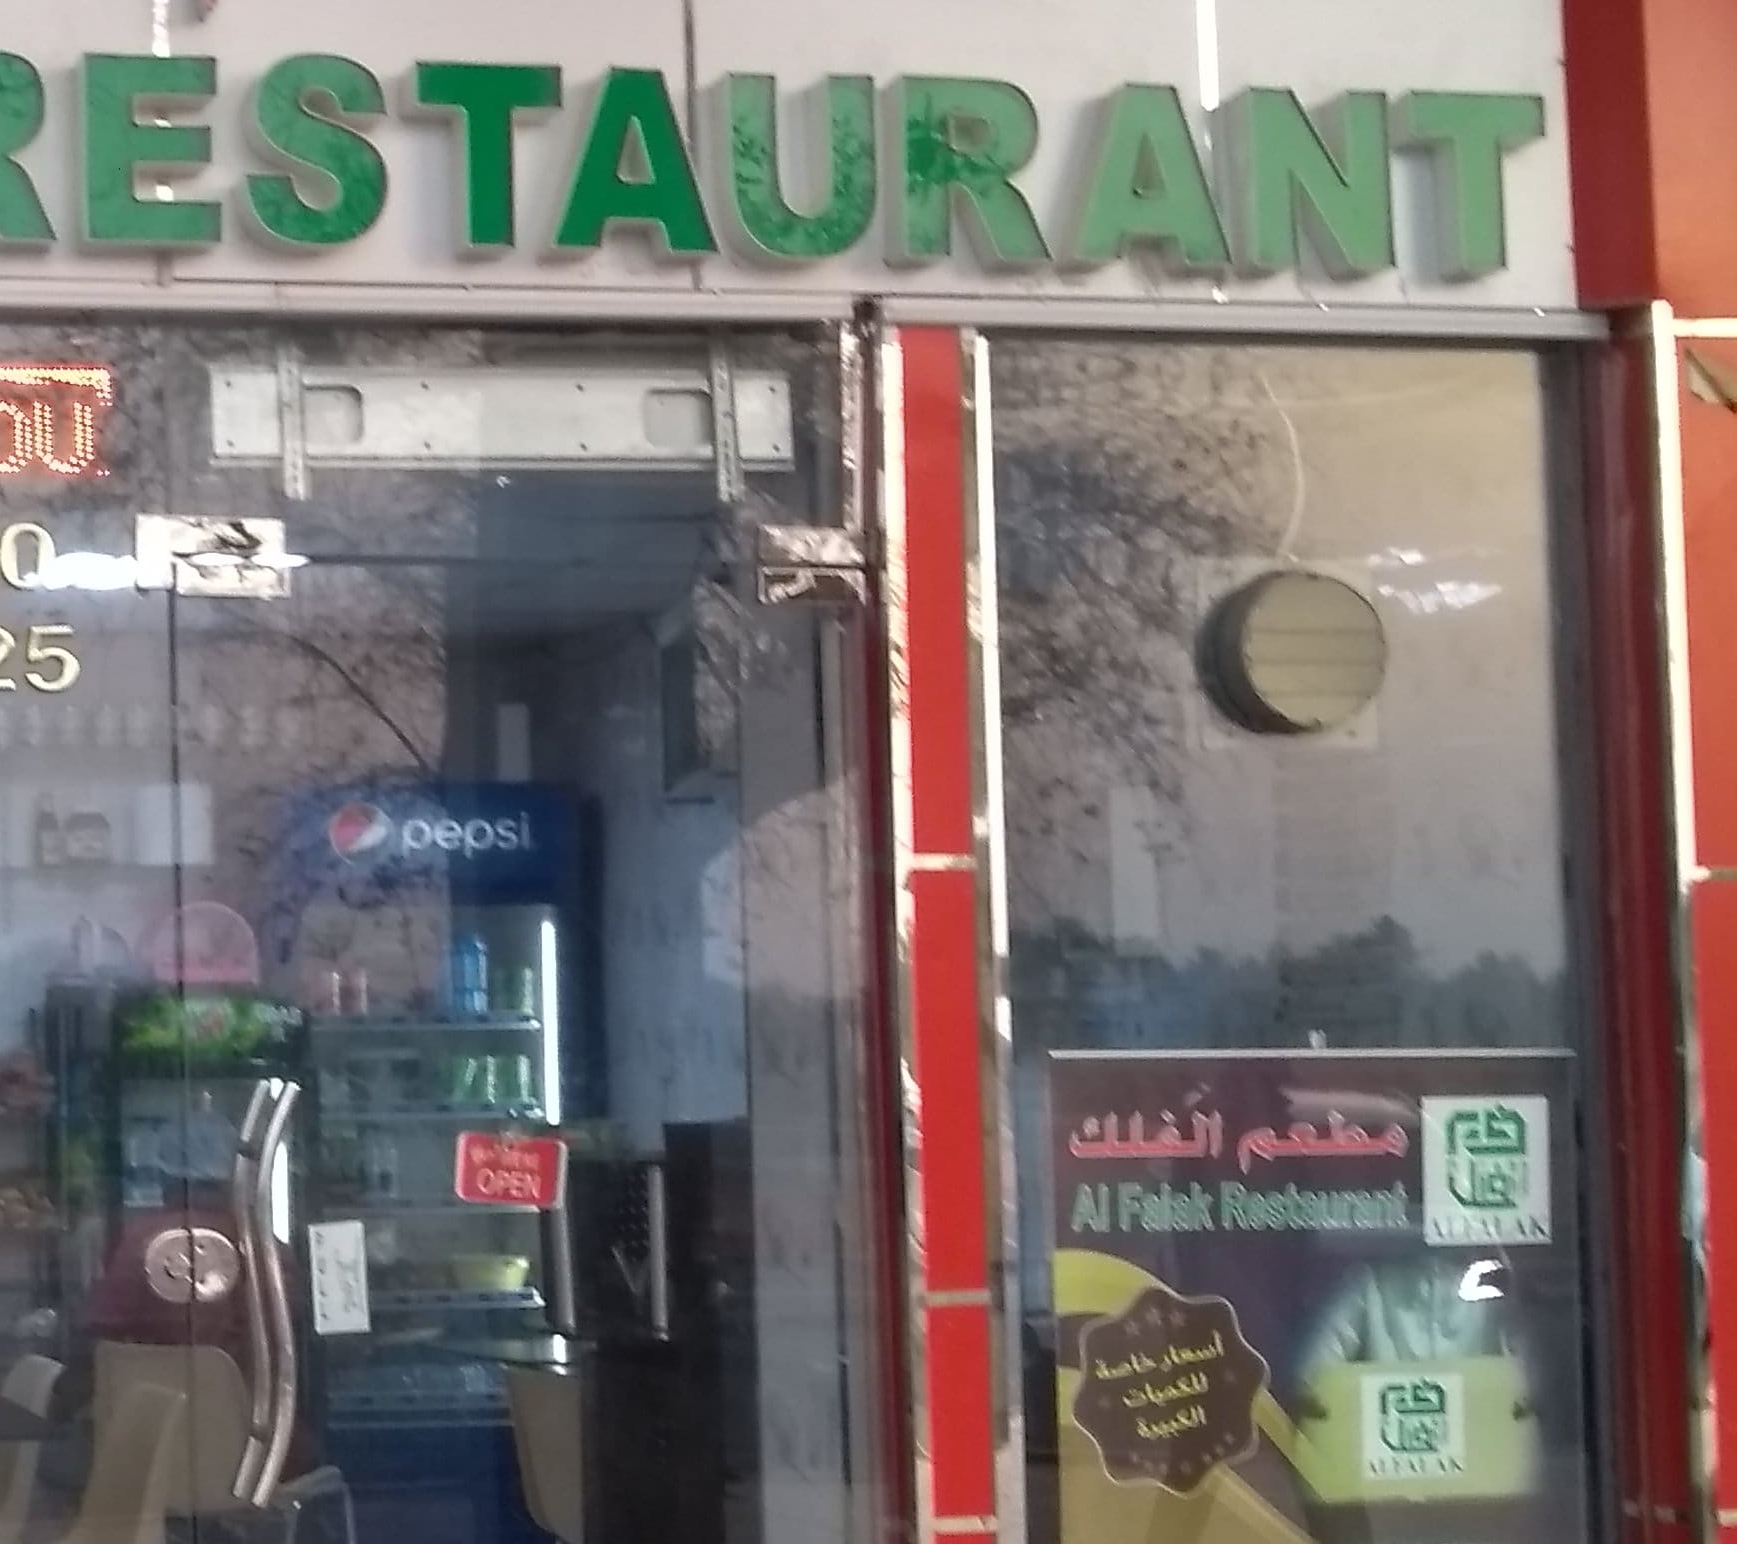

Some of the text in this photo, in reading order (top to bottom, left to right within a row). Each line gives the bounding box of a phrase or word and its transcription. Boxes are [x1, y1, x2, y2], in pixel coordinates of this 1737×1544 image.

[402, 811, 531, 859] pepsi
[1068, 1108, 1223, 1159] الفلك
[1237, 1111, 1409, 1174] مطعم
[477, 1168, 541, 1199] OPEN
[1072, 1181, 1410, 1232] Al Falak Restaurant
[1095, 1352, 1157, 1380] خاصة
[1122, 1372, 1209, 1407] للكميات
[1136, 1405, 1207, 1439] الكبيرة
